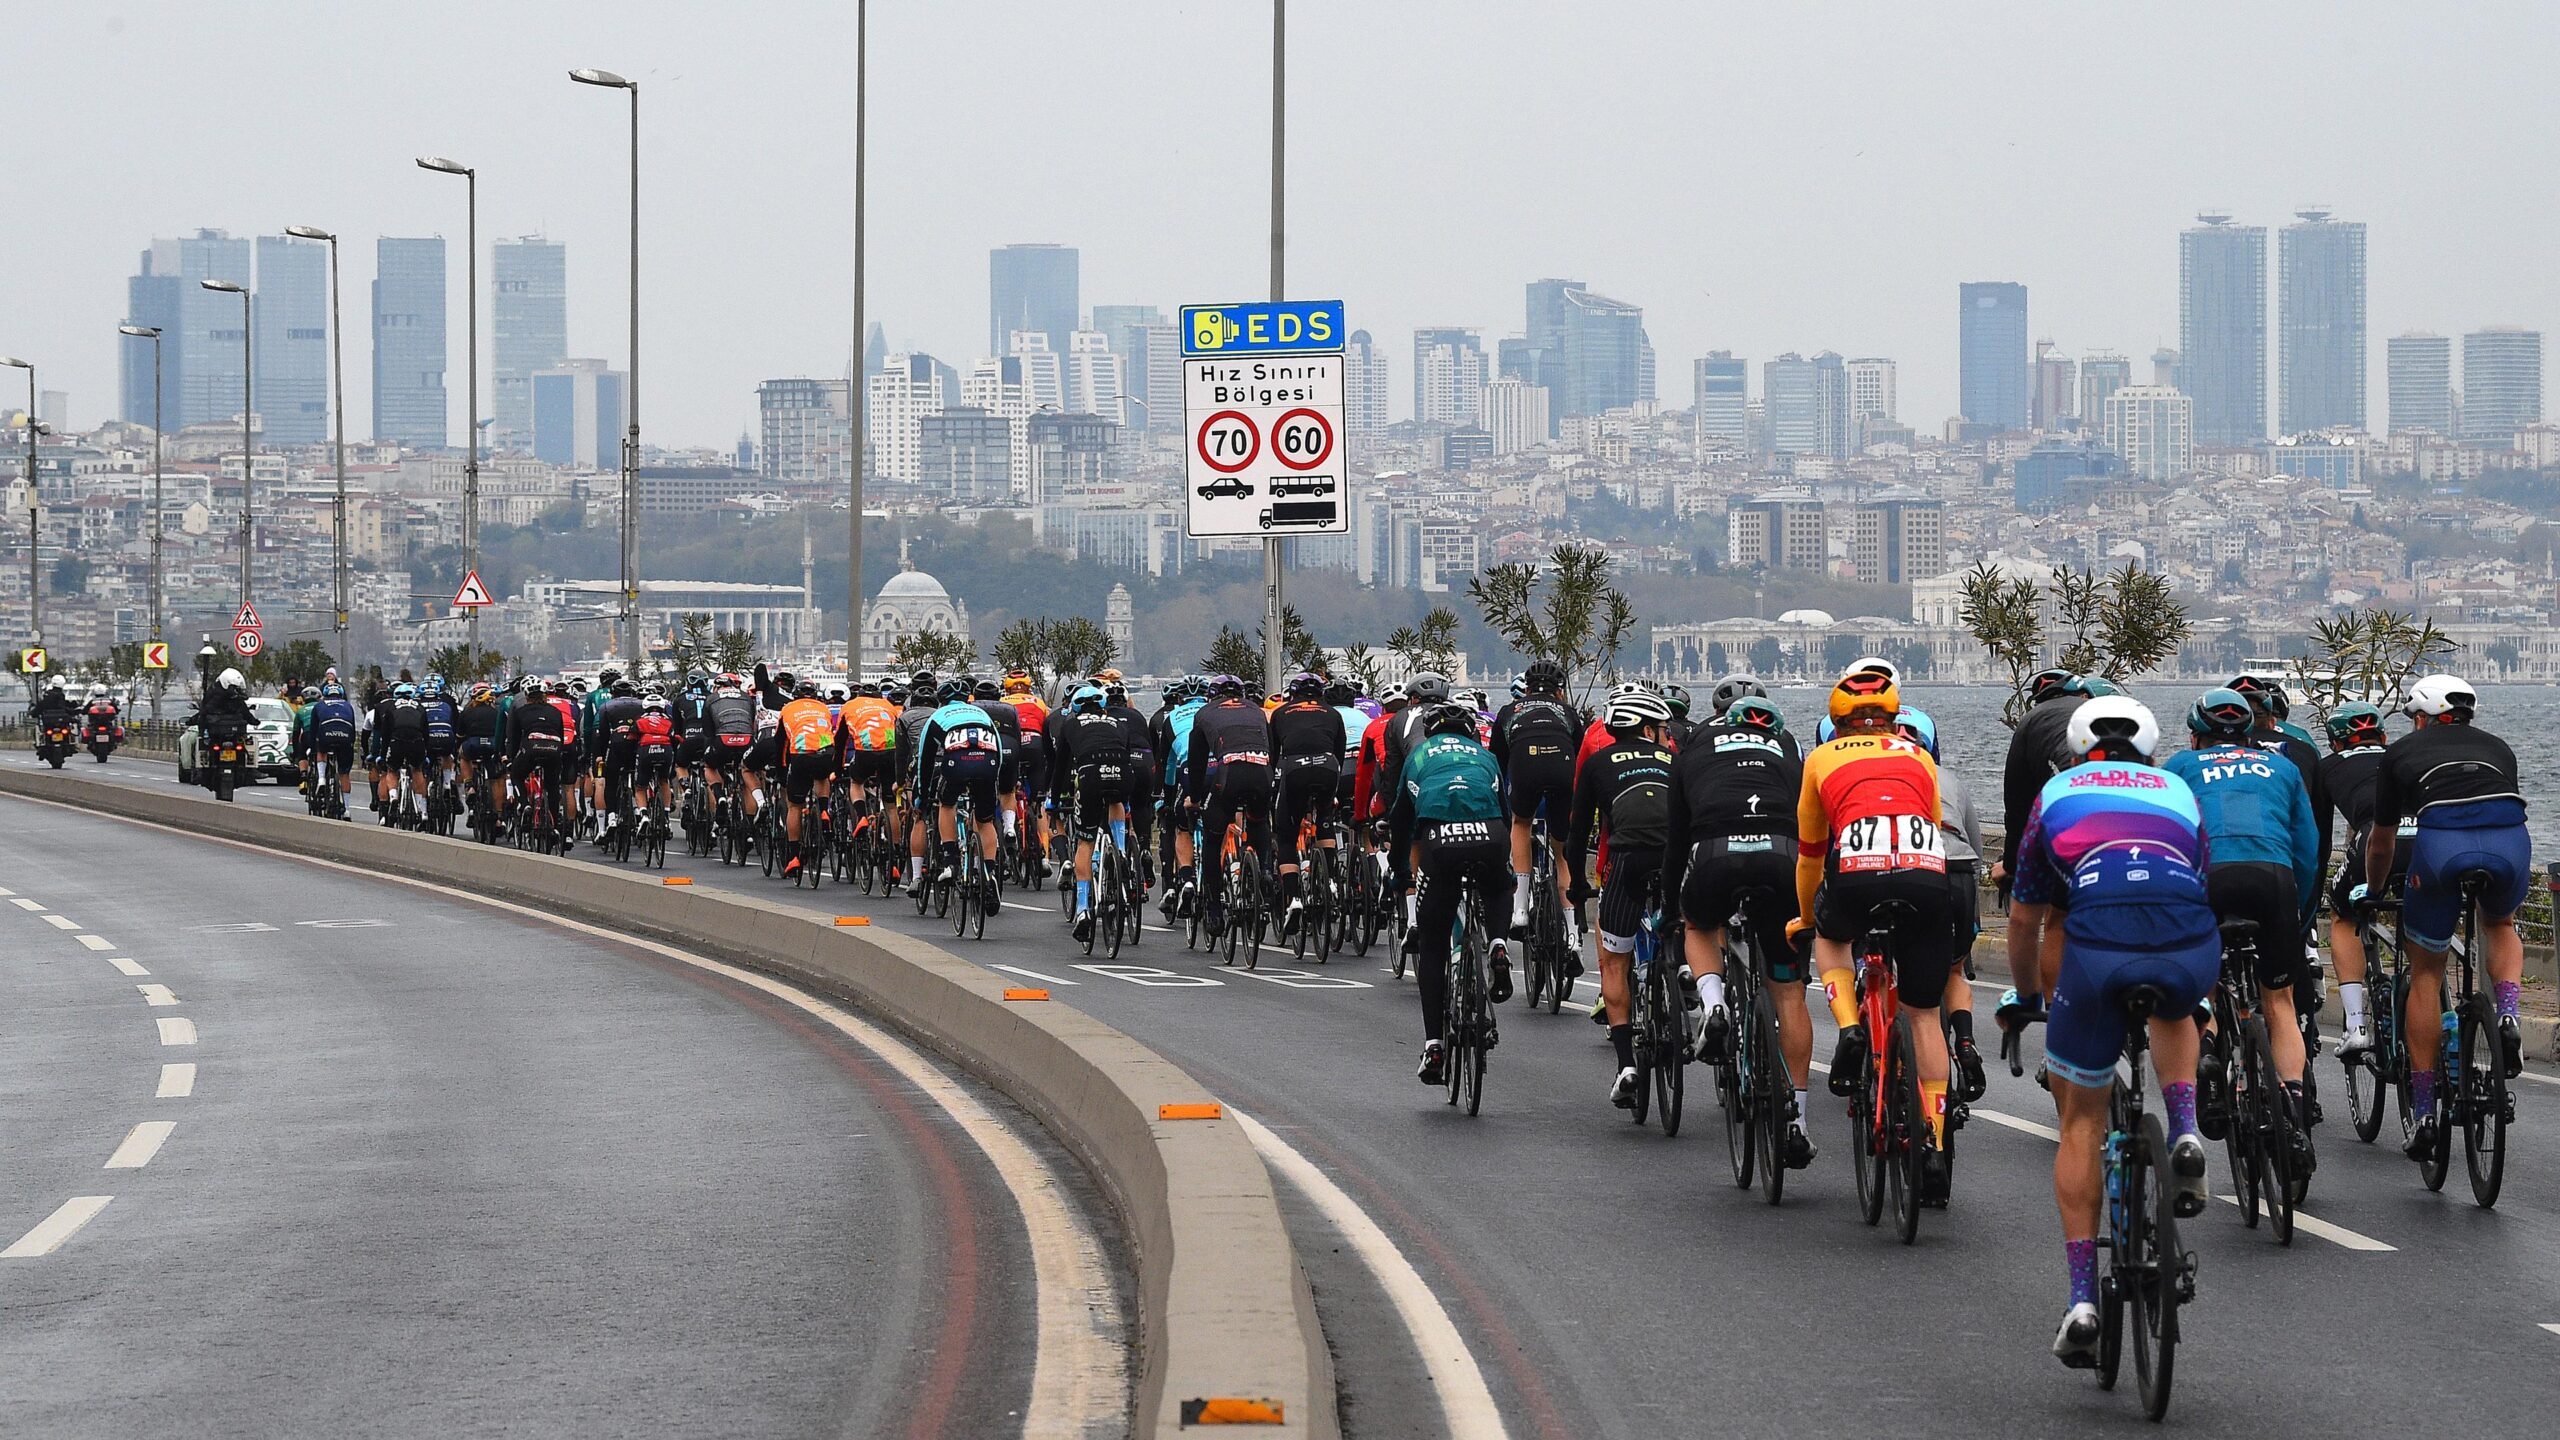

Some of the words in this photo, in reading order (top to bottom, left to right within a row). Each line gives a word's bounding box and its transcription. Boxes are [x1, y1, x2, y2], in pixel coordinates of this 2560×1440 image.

[1247, 311, 1332, 343] EDS
[1201, 366, 1241, 382] Hız
[1253, 364, 1325, 380] Sınırı
[1214, 385, 1314, 405] Bölgesi
[1211, 428, 1247, 456] 70
[1284, 425, 1322, 455] 60
[240, 635, 257, 648] 30
[948, 729, 962, 743] 27
[1713, 732, 1784, 752] BORA
[1834, 741, 1875, 751] Uno
[2201, 762, 2272, 784] HYLO
[1440, 822, 1489, 839] KERN
[1441, 835, 1491, 845] PHARMA
[1849, 817, 1879, 852] 87
[1909, 815, 1934, 851] 87
